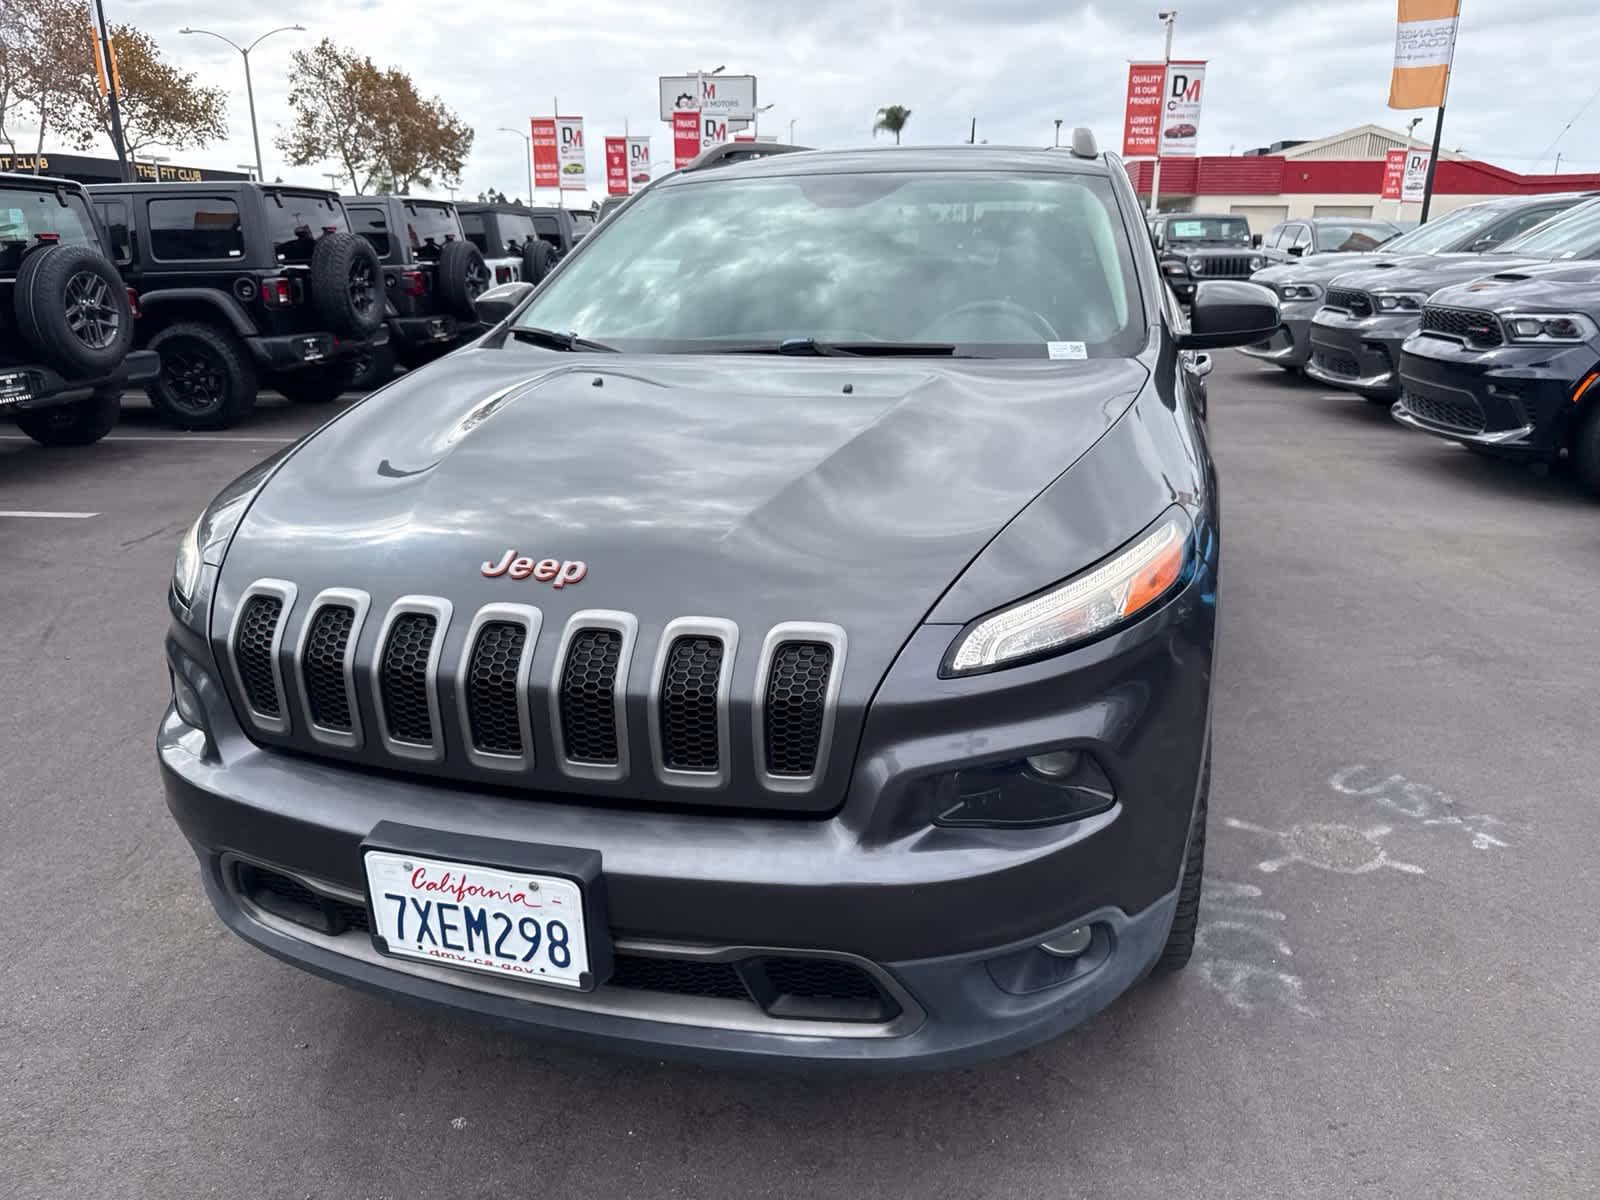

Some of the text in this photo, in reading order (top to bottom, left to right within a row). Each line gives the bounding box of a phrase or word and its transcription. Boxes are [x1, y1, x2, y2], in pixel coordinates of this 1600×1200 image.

[1132, 75, 1161, 84] QUALITY
[1135, 86, 1157, 94] IS OUR
[1130, 97, 1160, 105] PRIORITY
[1130, 116, 1157, 124] LOWEST
[1131, 126, 1154, 135] PRICES
[1127, 137, 1156, 145] IN TOWN
[136, 164, 202, 183] THE FIT CLUB
[480, 549, 588, 589] Jeep
[411, 867, 542, 909] California
[384, 892, 571, 969] 7XEM298
